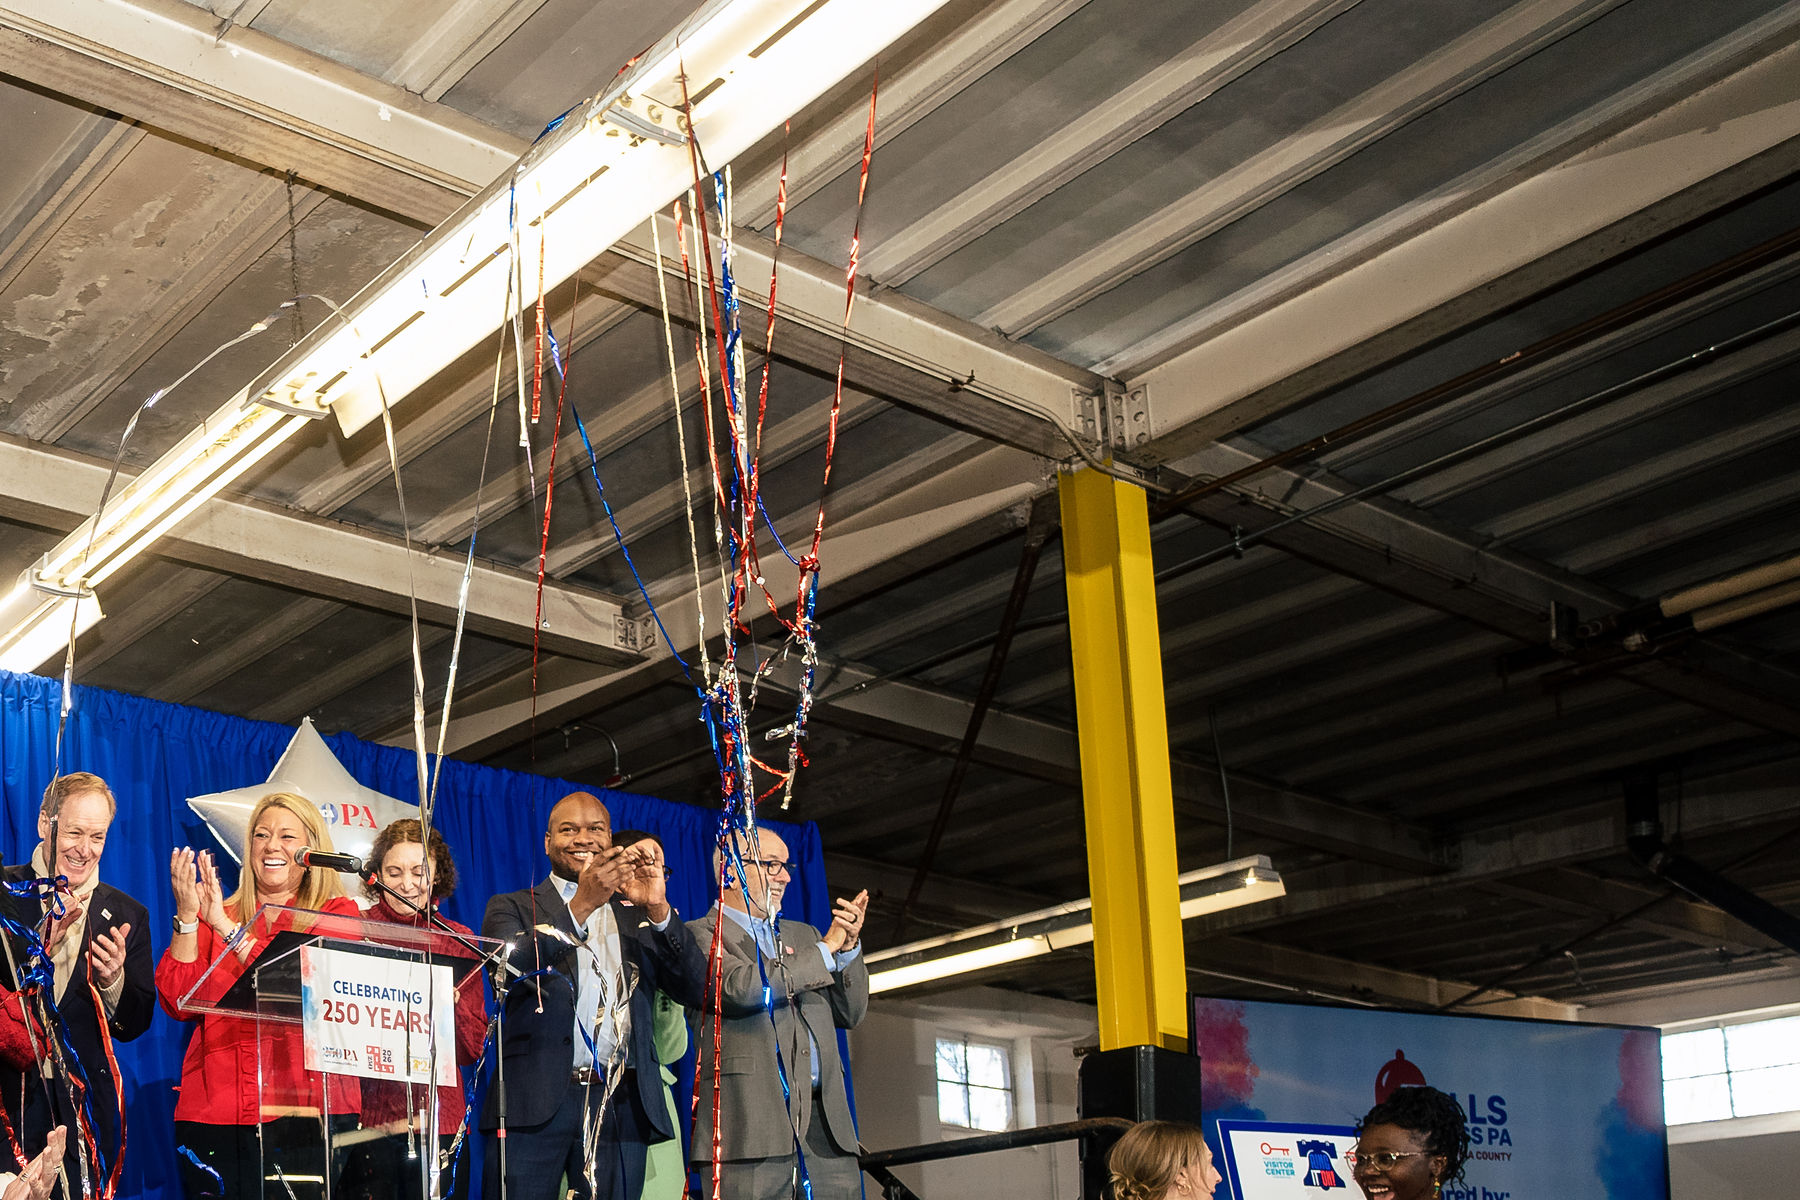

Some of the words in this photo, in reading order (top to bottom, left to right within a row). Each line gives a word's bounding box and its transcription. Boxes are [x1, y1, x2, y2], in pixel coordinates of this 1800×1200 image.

[333, 980, 422, 1005] CELEBRATING
[322, 999, 360, 1026] 250
[1488, 1127, 1512, 1147] PA
[1476, 1151, 1512, 1161] COUNTY
[1266, 1168, 1295, 1176] CENTER
